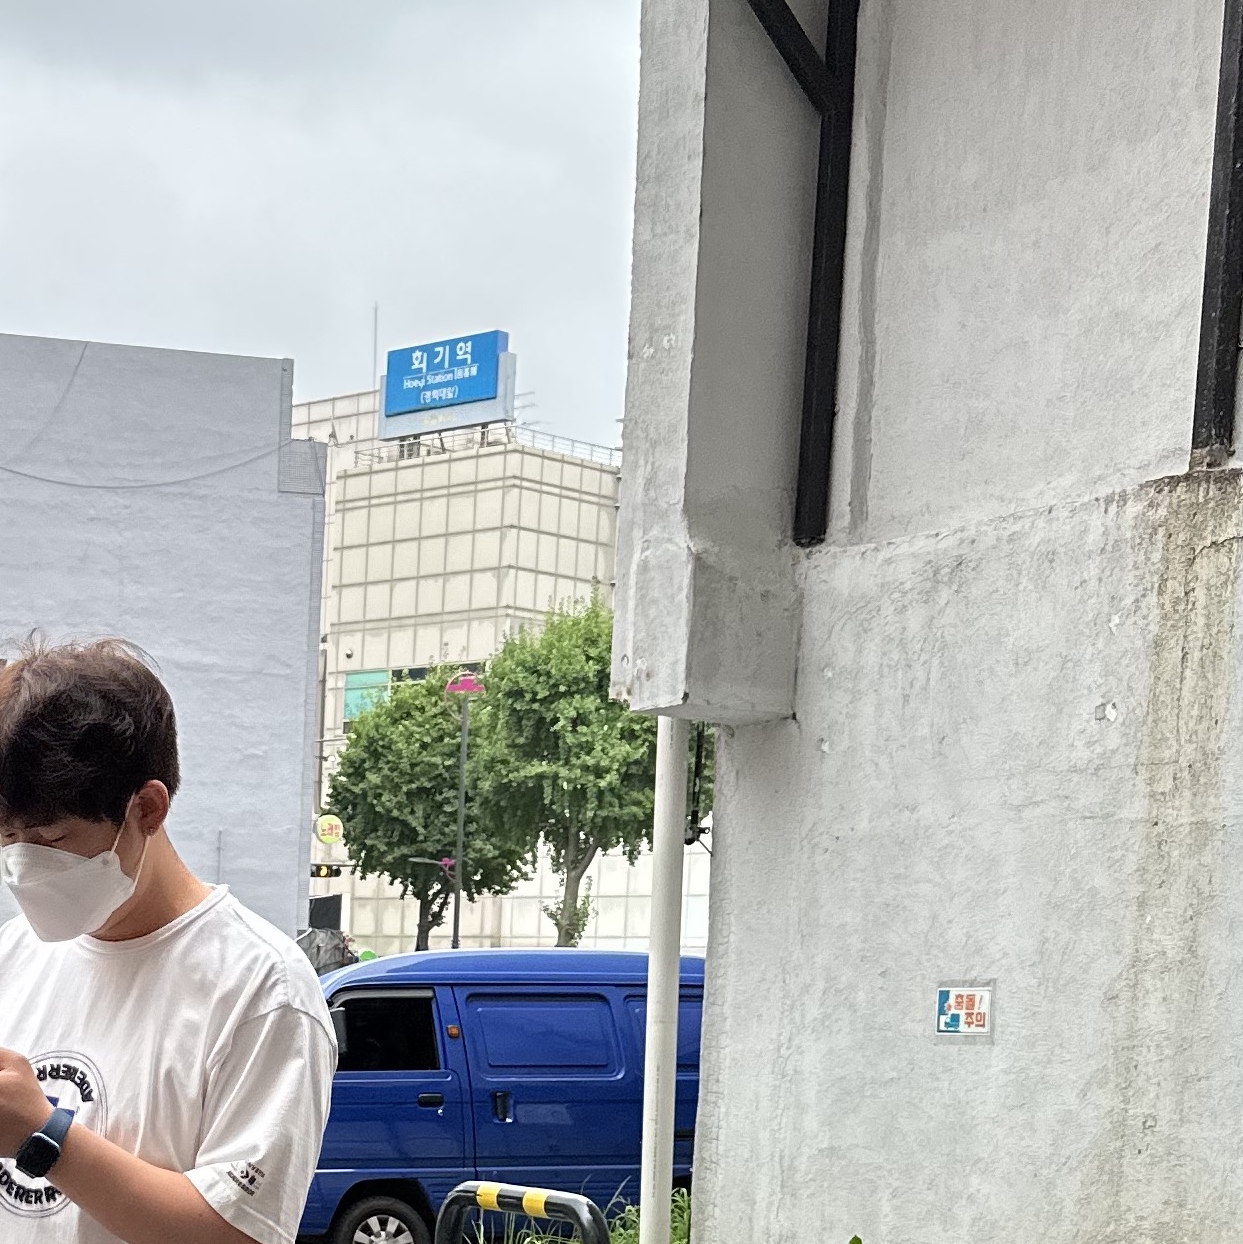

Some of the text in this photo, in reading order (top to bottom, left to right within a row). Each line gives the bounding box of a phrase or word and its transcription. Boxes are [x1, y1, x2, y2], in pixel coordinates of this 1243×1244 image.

[411, 340, 472, 374] 회기역
[426, 372, 454, 385] Station
[964, 1011, 986, 1029] 주의
[37, 1063, 94, 1102] ADERERR
